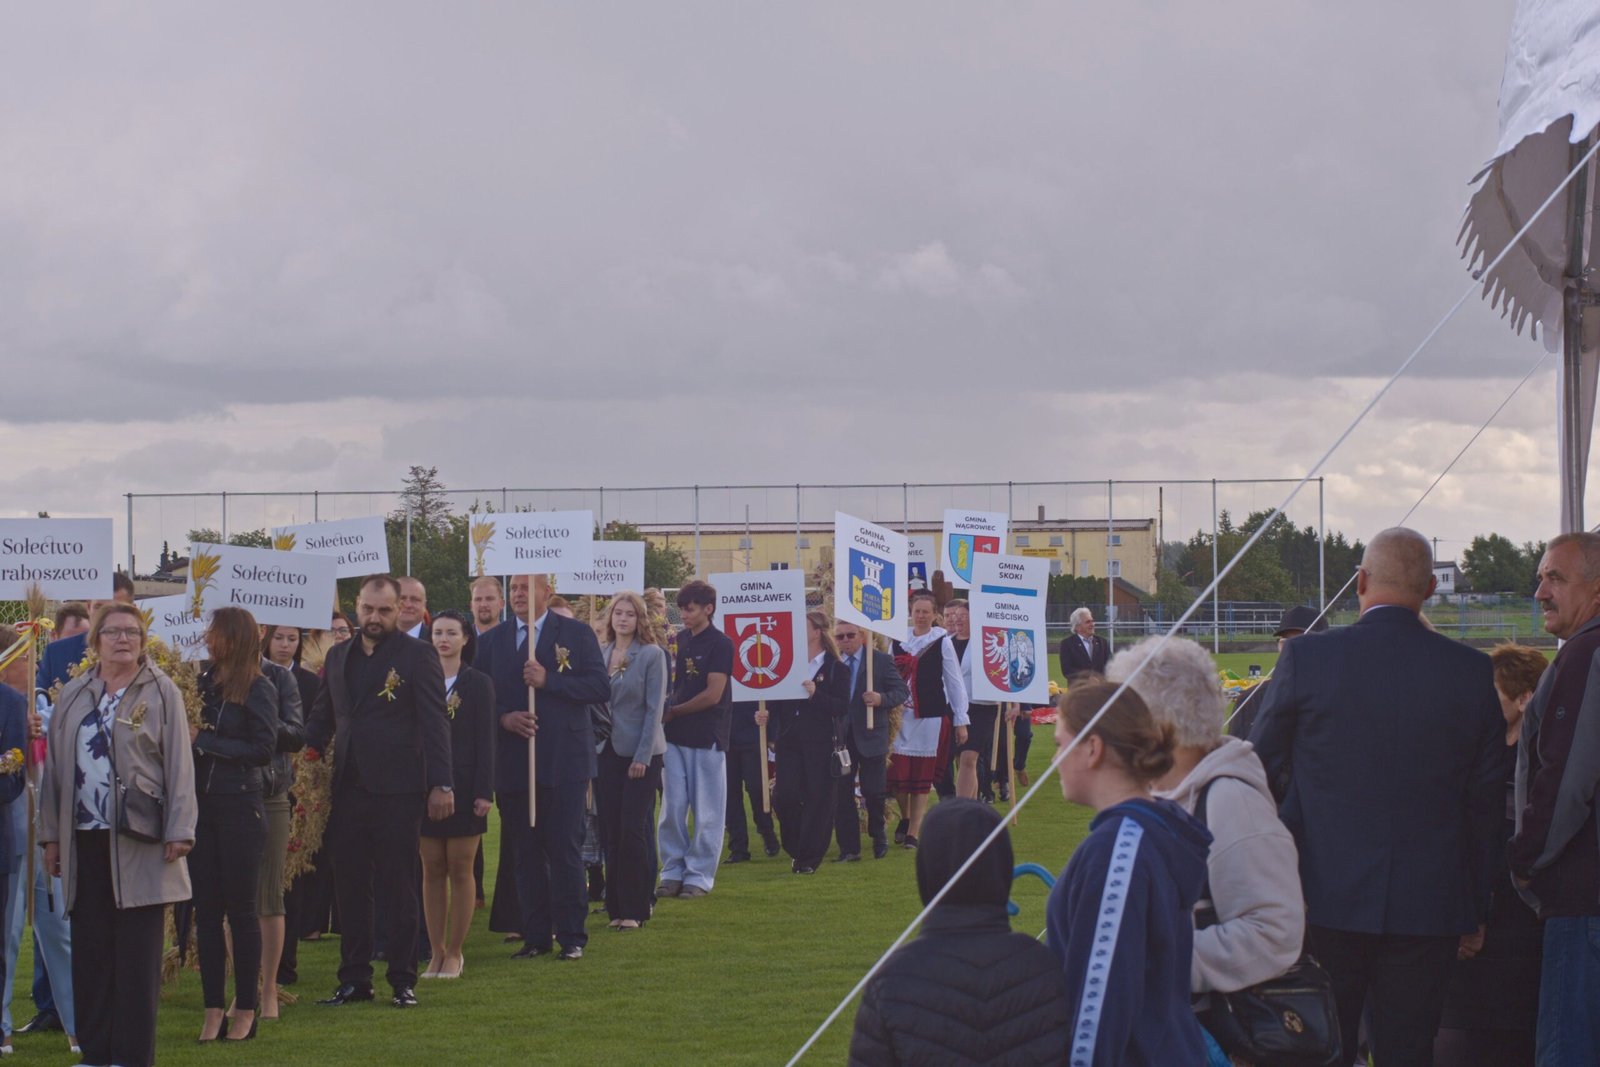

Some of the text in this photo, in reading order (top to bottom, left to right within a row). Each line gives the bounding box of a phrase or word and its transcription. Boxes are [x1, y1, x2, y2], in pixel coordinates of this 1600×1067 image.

[859, 526, 886, 542] GMINA
[955, 523, 997, 531] WĄGROWIEC
[2, 535, 83, 555] Sołectwo
[854, 534, 891, 554] GOŁAŃCZ
[347, 550, 380, 564] Góra
[514, 545, 563, 560] Rusiec
[0, 563, 99, 581] raboszewo
[998, 562, 1025, 572] GMINA
[231, 563, 307, 586] Sołectwo
[999, 571, 1023, 580] SKOKI
[740, 581, 773, 591] GMINA
[230, 588, 305, 609] Komasin
[721, 592, 792, 604] DAMASŁAWEK
[994, 602, 1020, 611] GMINA
[986, 611, 1029, 622] MIEŚCISKO
